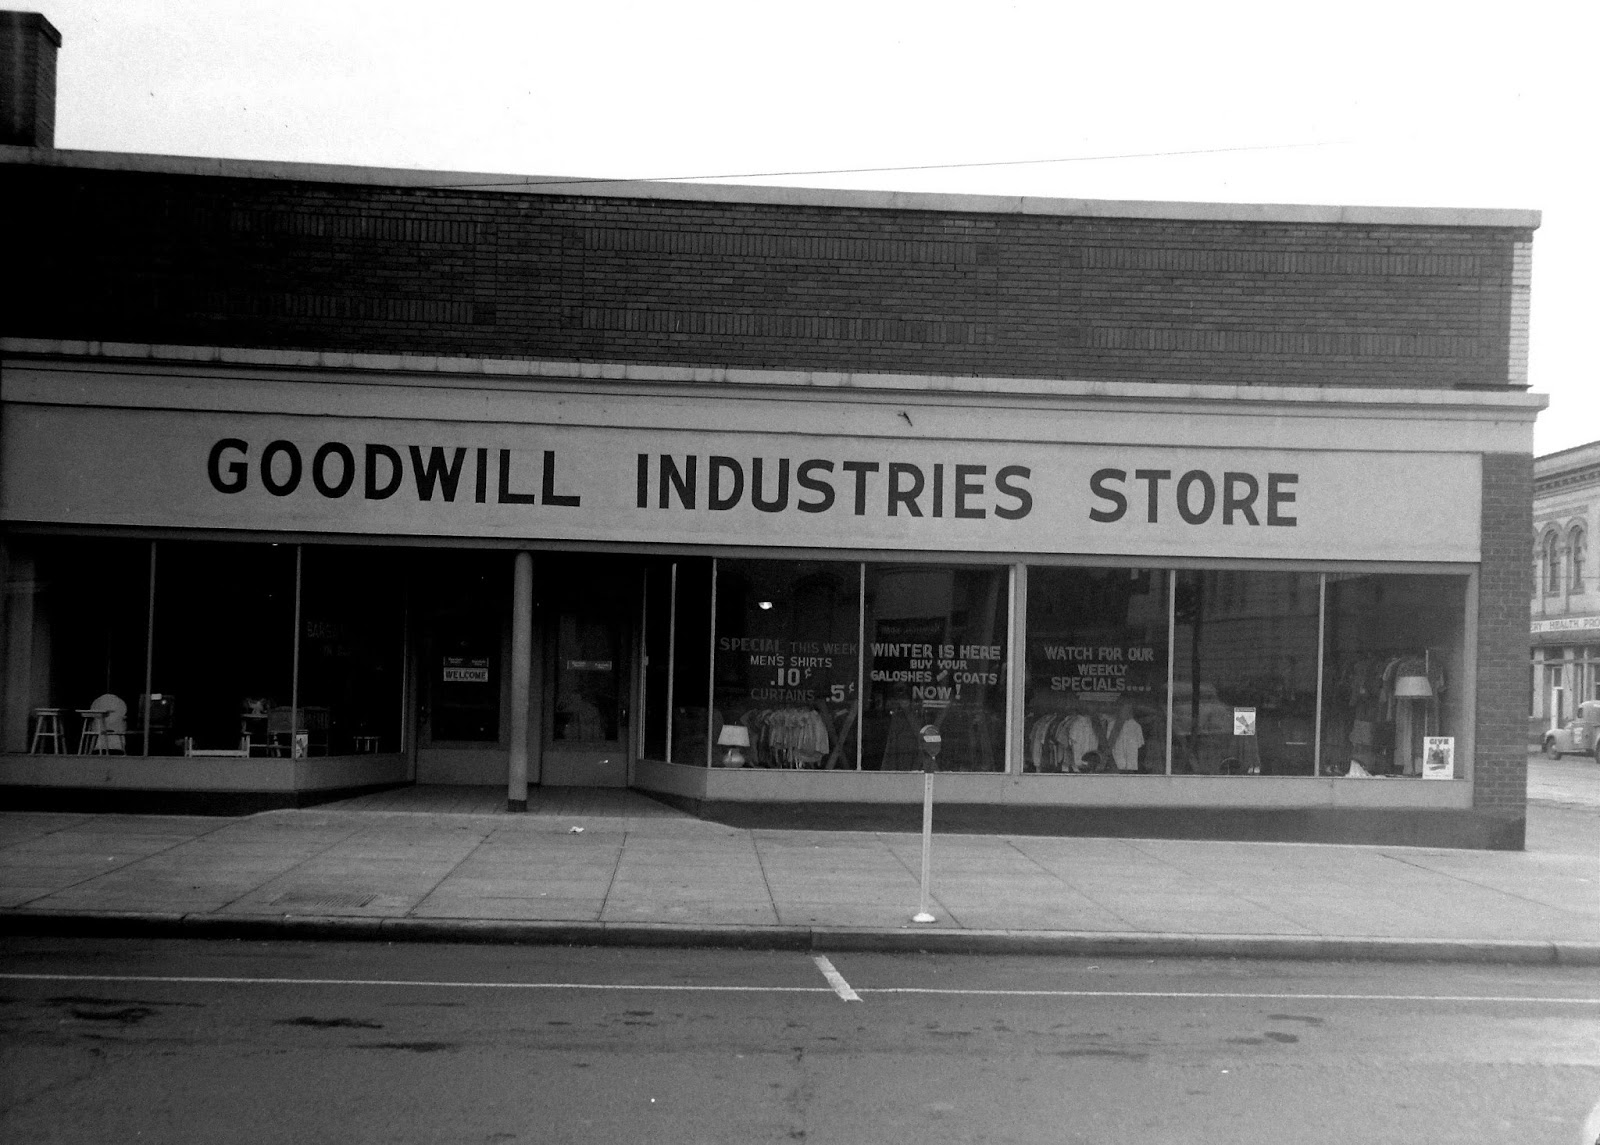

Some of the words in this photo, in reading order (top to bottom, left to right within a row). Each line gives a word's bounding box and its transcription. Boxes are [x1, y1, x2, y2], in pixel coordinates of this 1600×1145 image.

[207, 437, 581, 507] GOODWILL
[637, 453, 1033, 520] INDUSTRIES
[1088, 468, 1299, 527] STORE
[1549, 619, 1579, 630] HEALTH
[718, 636, 784, 653] SPECIAL
[789, 641, 820, 654] THIS
[822, 642, 857, 655] WEEK
[869, 642, 934, 658] WINTER
[938, 644, 955, 659] IS
[959, 644, 1001, 660] HERE
[750, 653, 785, 667] MEN'S
[790, 656, 833, 668] SHIRTS
[1043, 645, 1092, 661] WATCH
[1098, 646, 1123, 661] FOR
[1127, 647, 1154, 662] OUR
[909, 659, 933, 670] BUY
[937, 659, 968, 671] YOUR
[1077, 663, 1128, 676] WEEKLY
[445, 670, 486, 680] WELCOME
[869, 670, 932, 683] GALOSHES
[953, 672, 998, 685] COATS
[750, 687, 815, 702] CURTAINS
